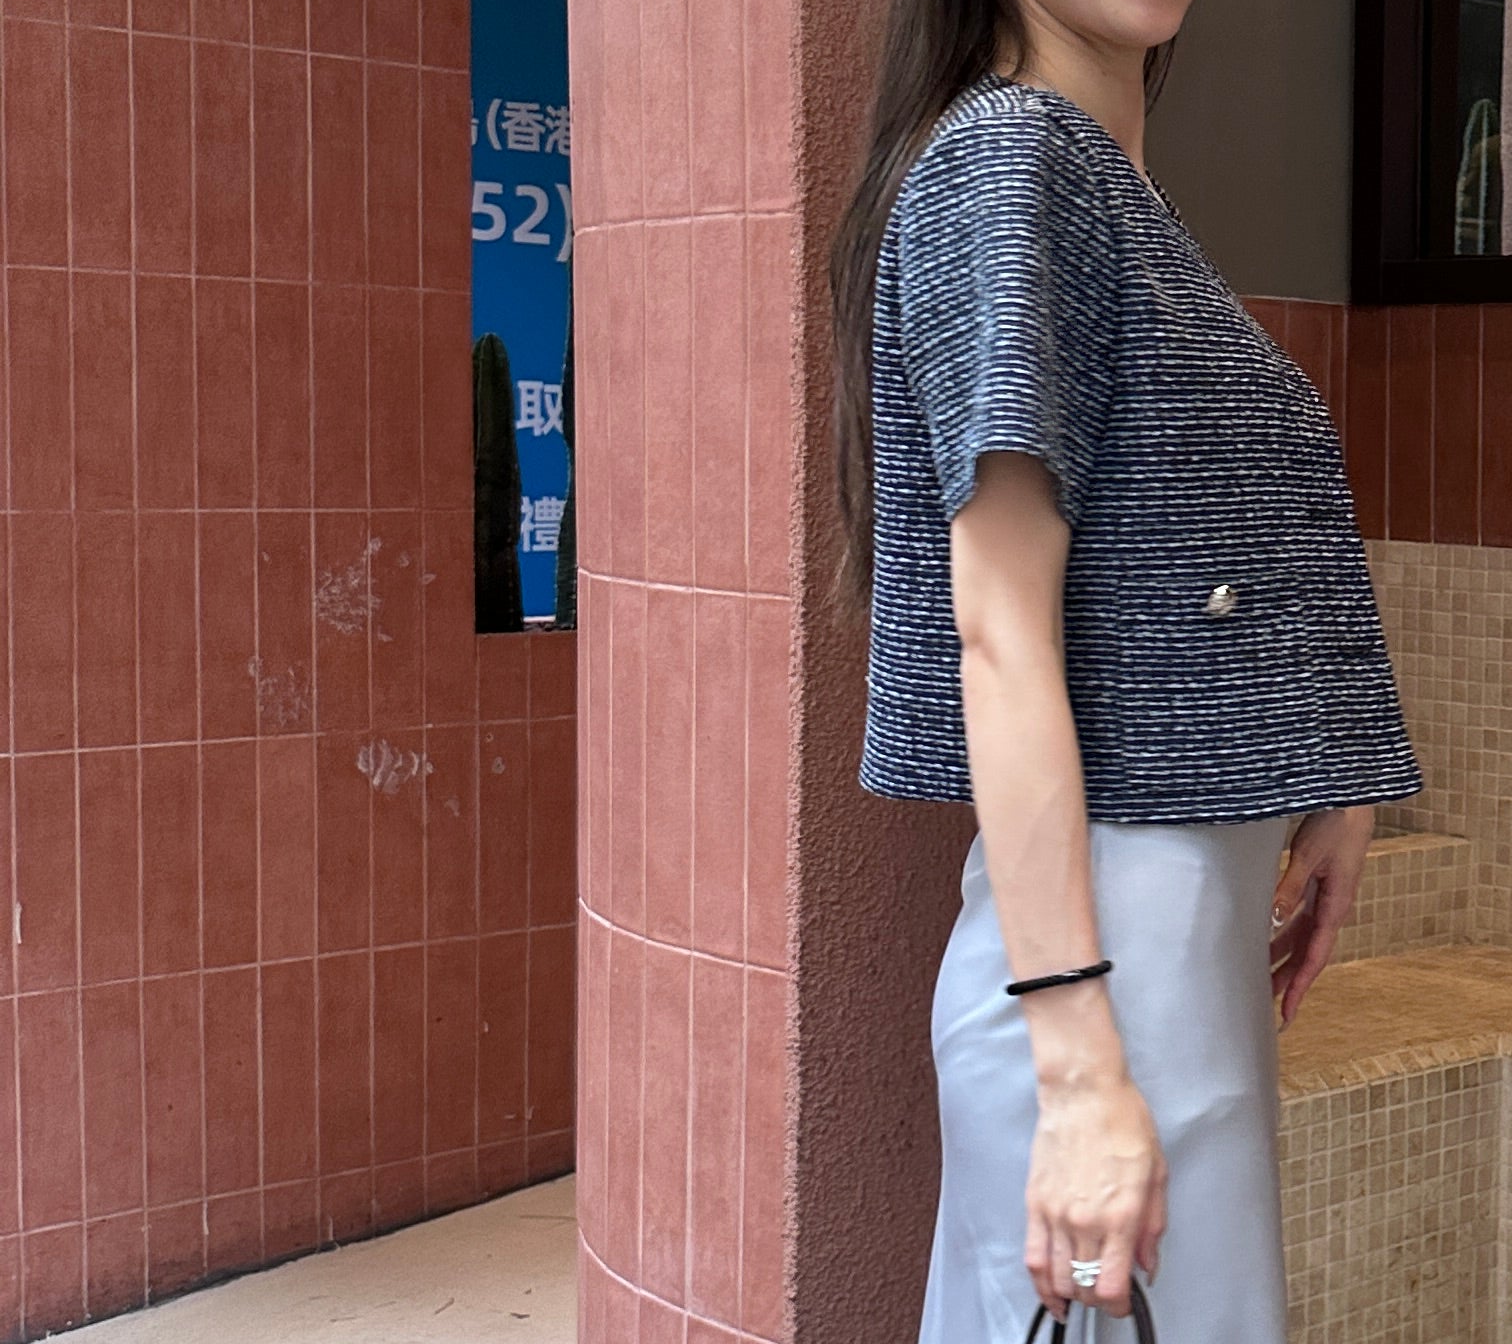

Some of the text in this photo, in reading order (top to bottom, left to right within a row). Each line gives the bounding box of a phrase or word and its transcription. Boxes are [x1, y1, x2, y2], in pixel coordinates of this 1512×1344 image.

[471, 97, 570, 156] (香港
[472, 181, 573, 262] 52)
[515, 379, 564, 437] 取
[520, 495, 567, 553] 禮
